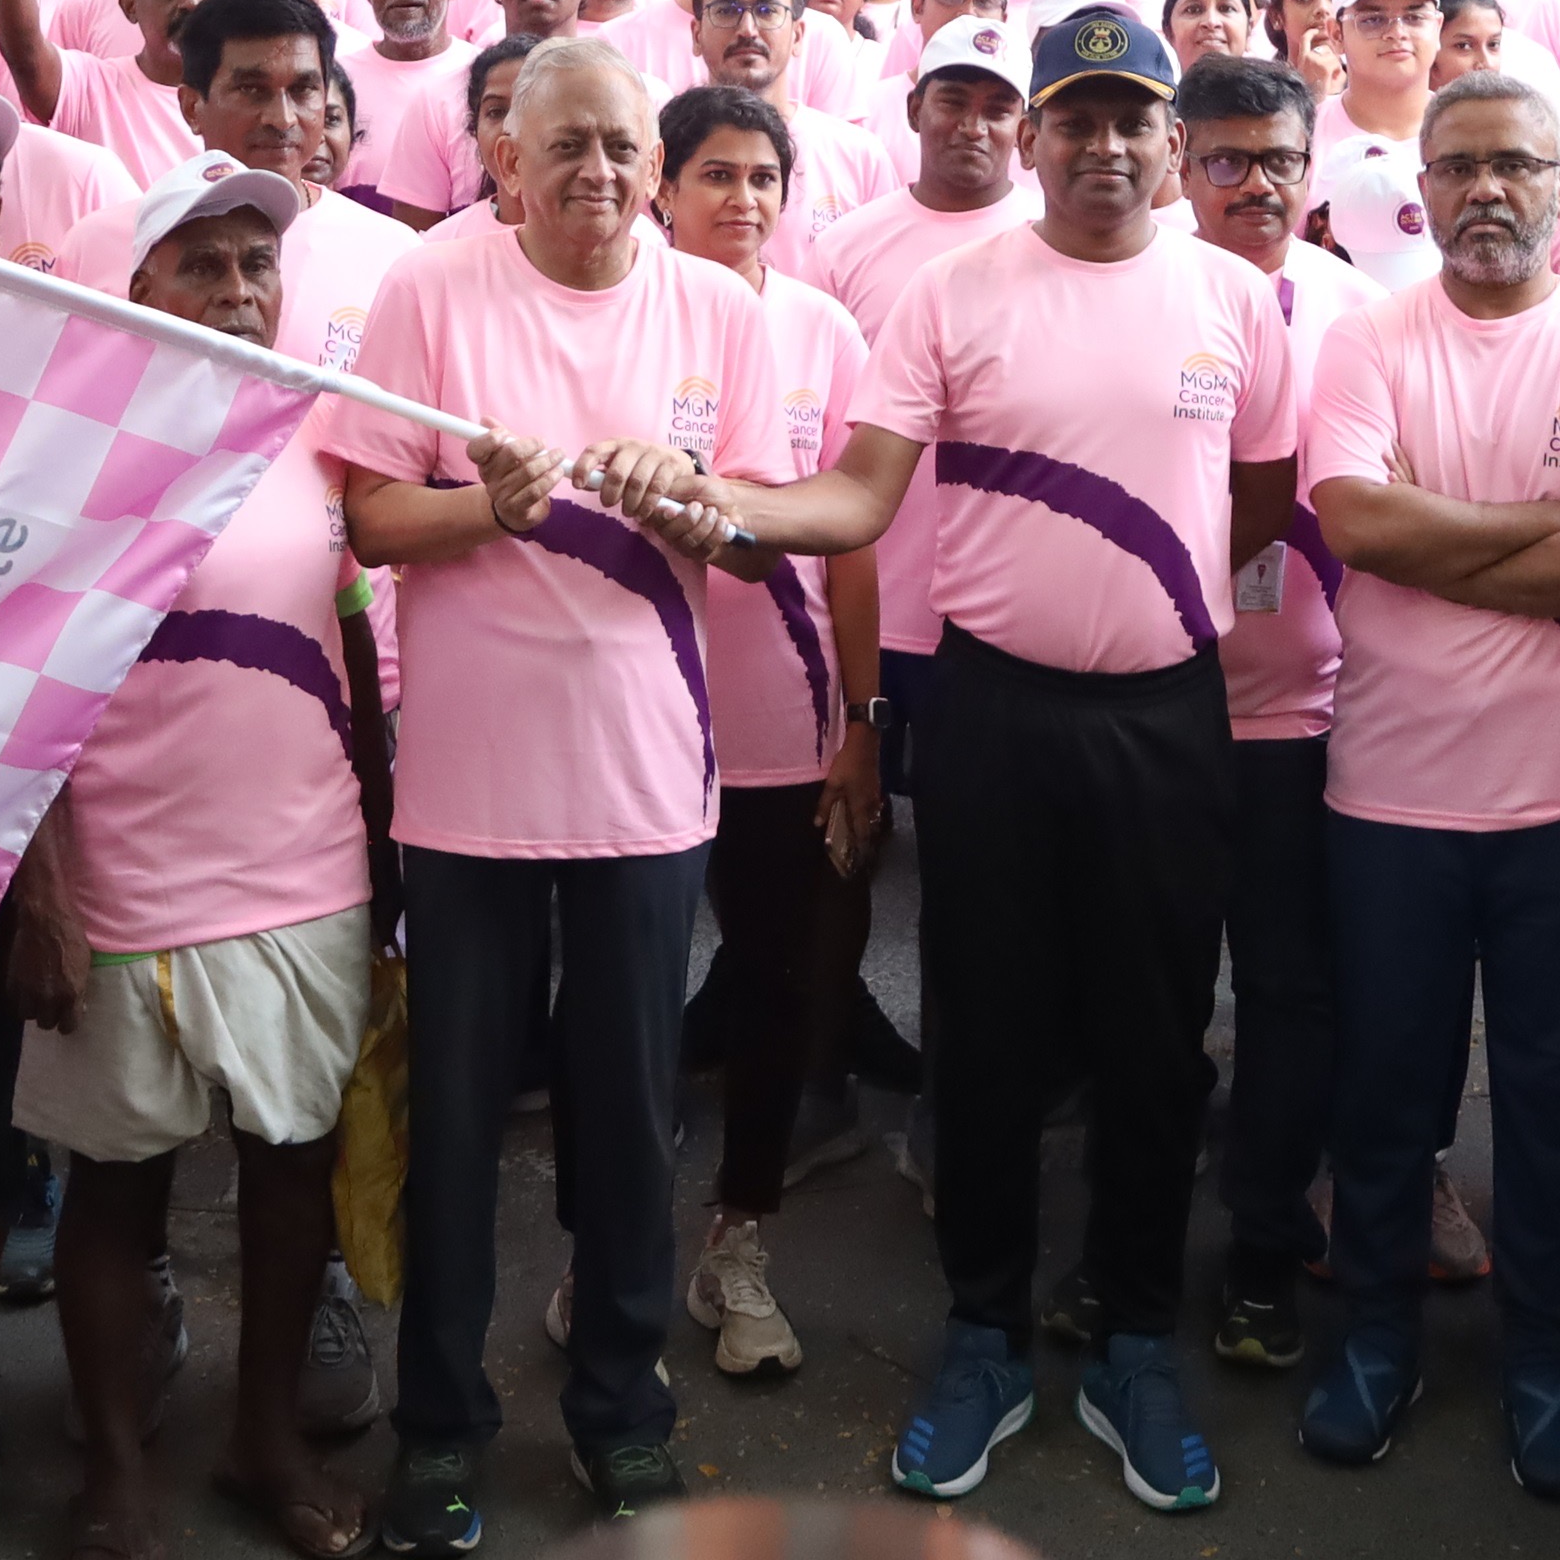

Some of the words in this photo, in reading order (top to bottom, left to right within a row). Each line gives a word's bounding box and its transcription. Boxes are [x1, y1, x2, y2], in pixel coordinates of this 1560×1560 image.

[1180, 370, 1228, 391] MGM
[1179, 390, 1225, 406] Cancer
[1173, 404, 1225, 421] Institute
[672, 416, 717, 435] Cance
